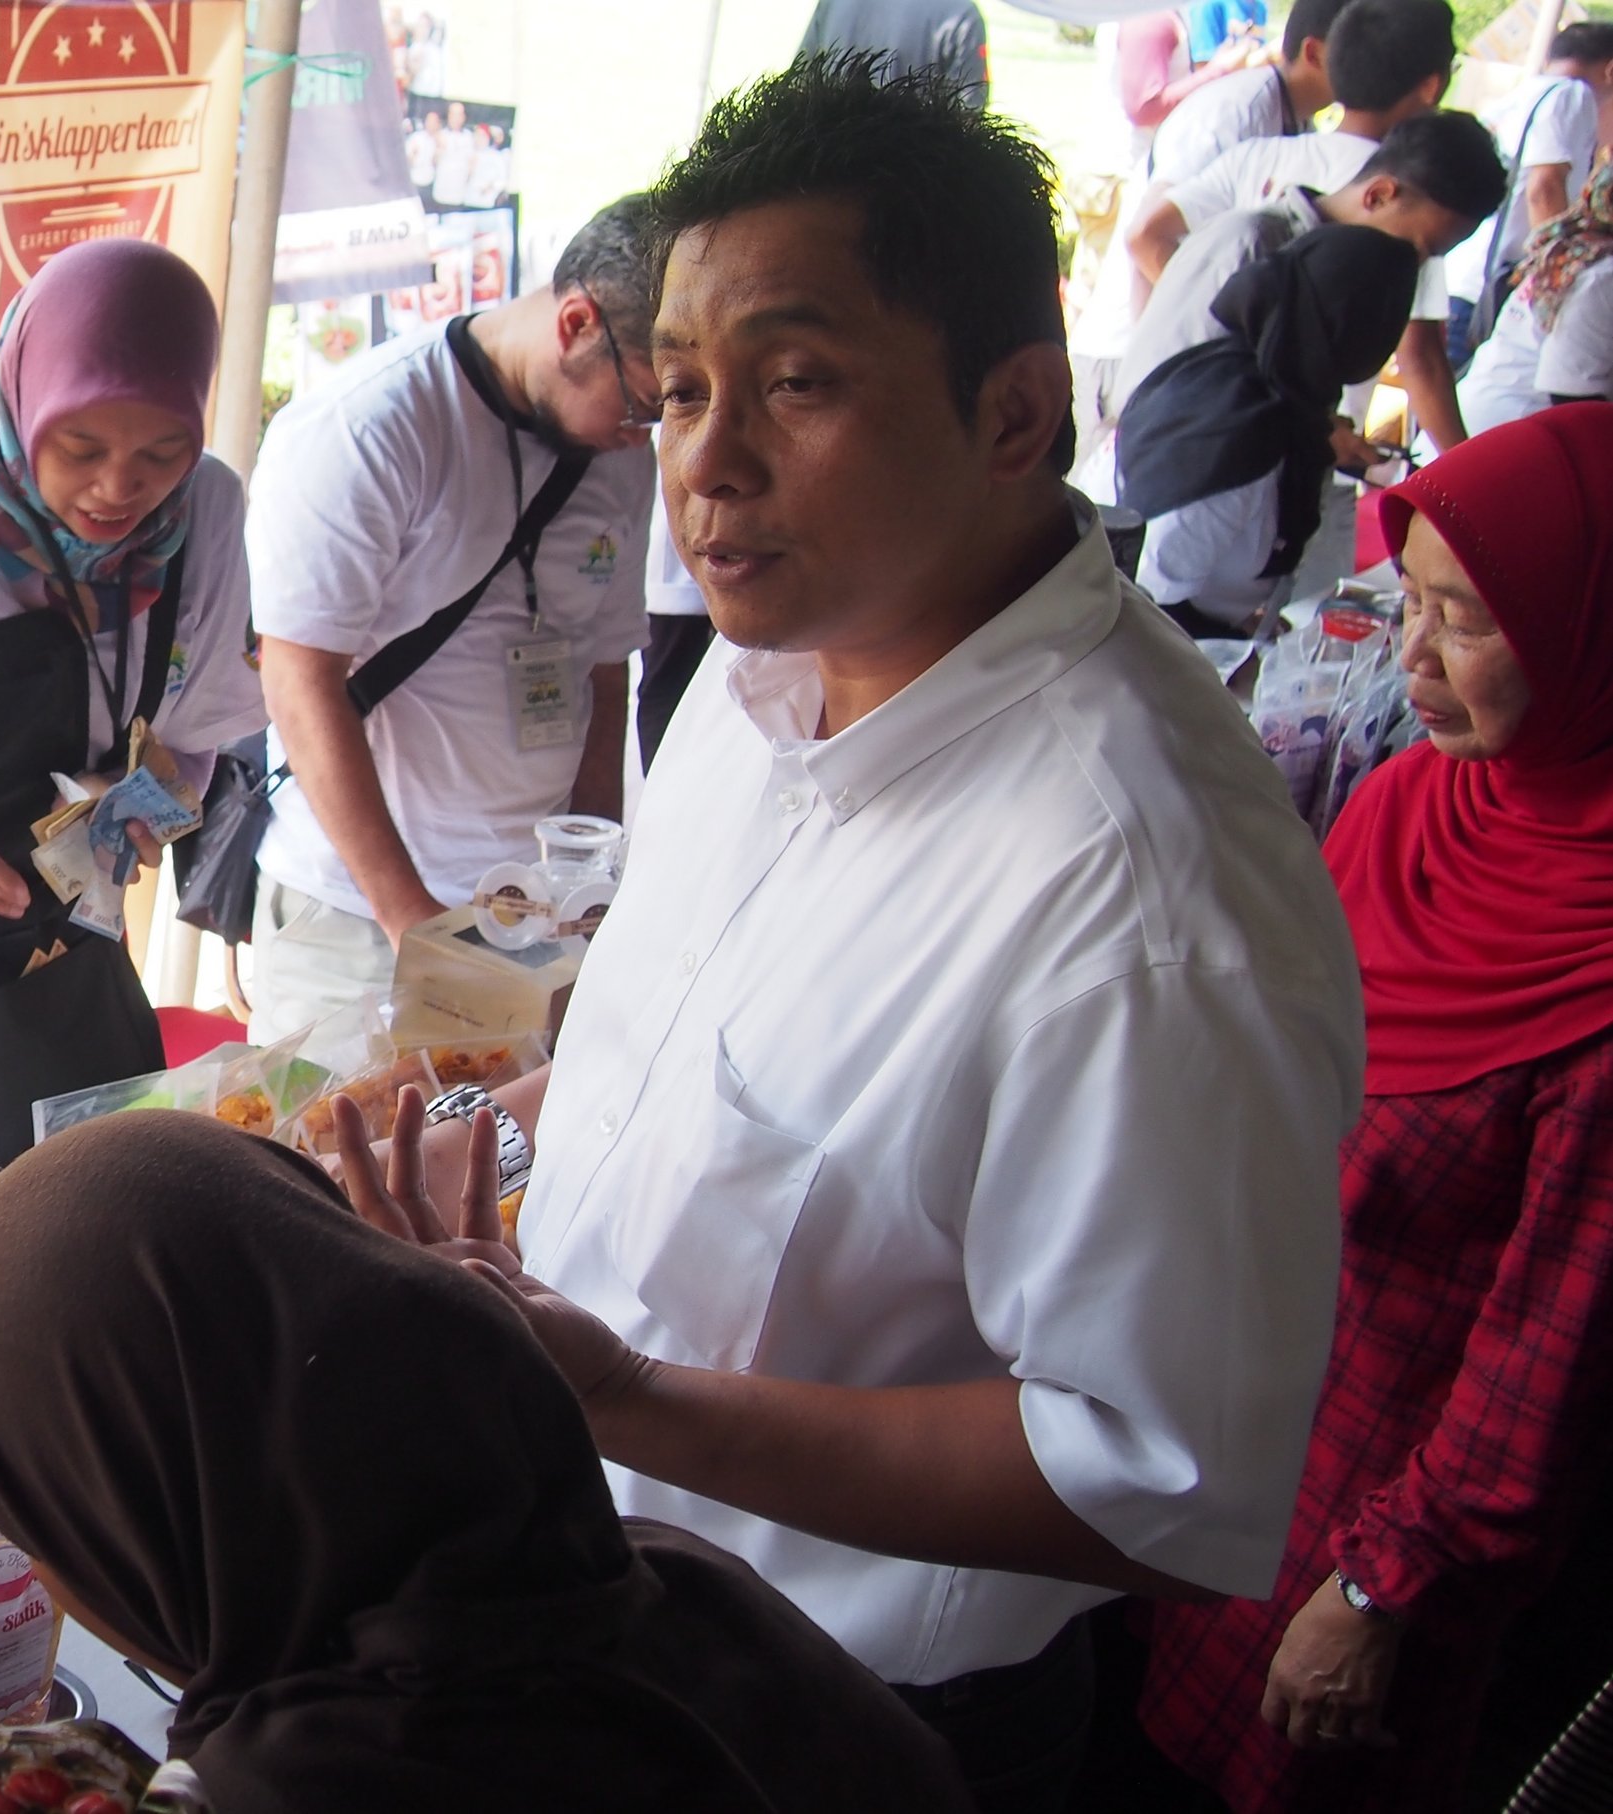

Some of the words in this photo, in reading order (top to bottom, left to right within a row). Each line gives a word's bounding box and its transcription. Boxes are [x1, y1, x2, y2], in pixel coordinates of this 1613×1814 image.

[19, 228, 68, 252] EXPERT
[7, 1552, 31, 1570] Ku
[1, 1599, 47, 1634] Sistik
